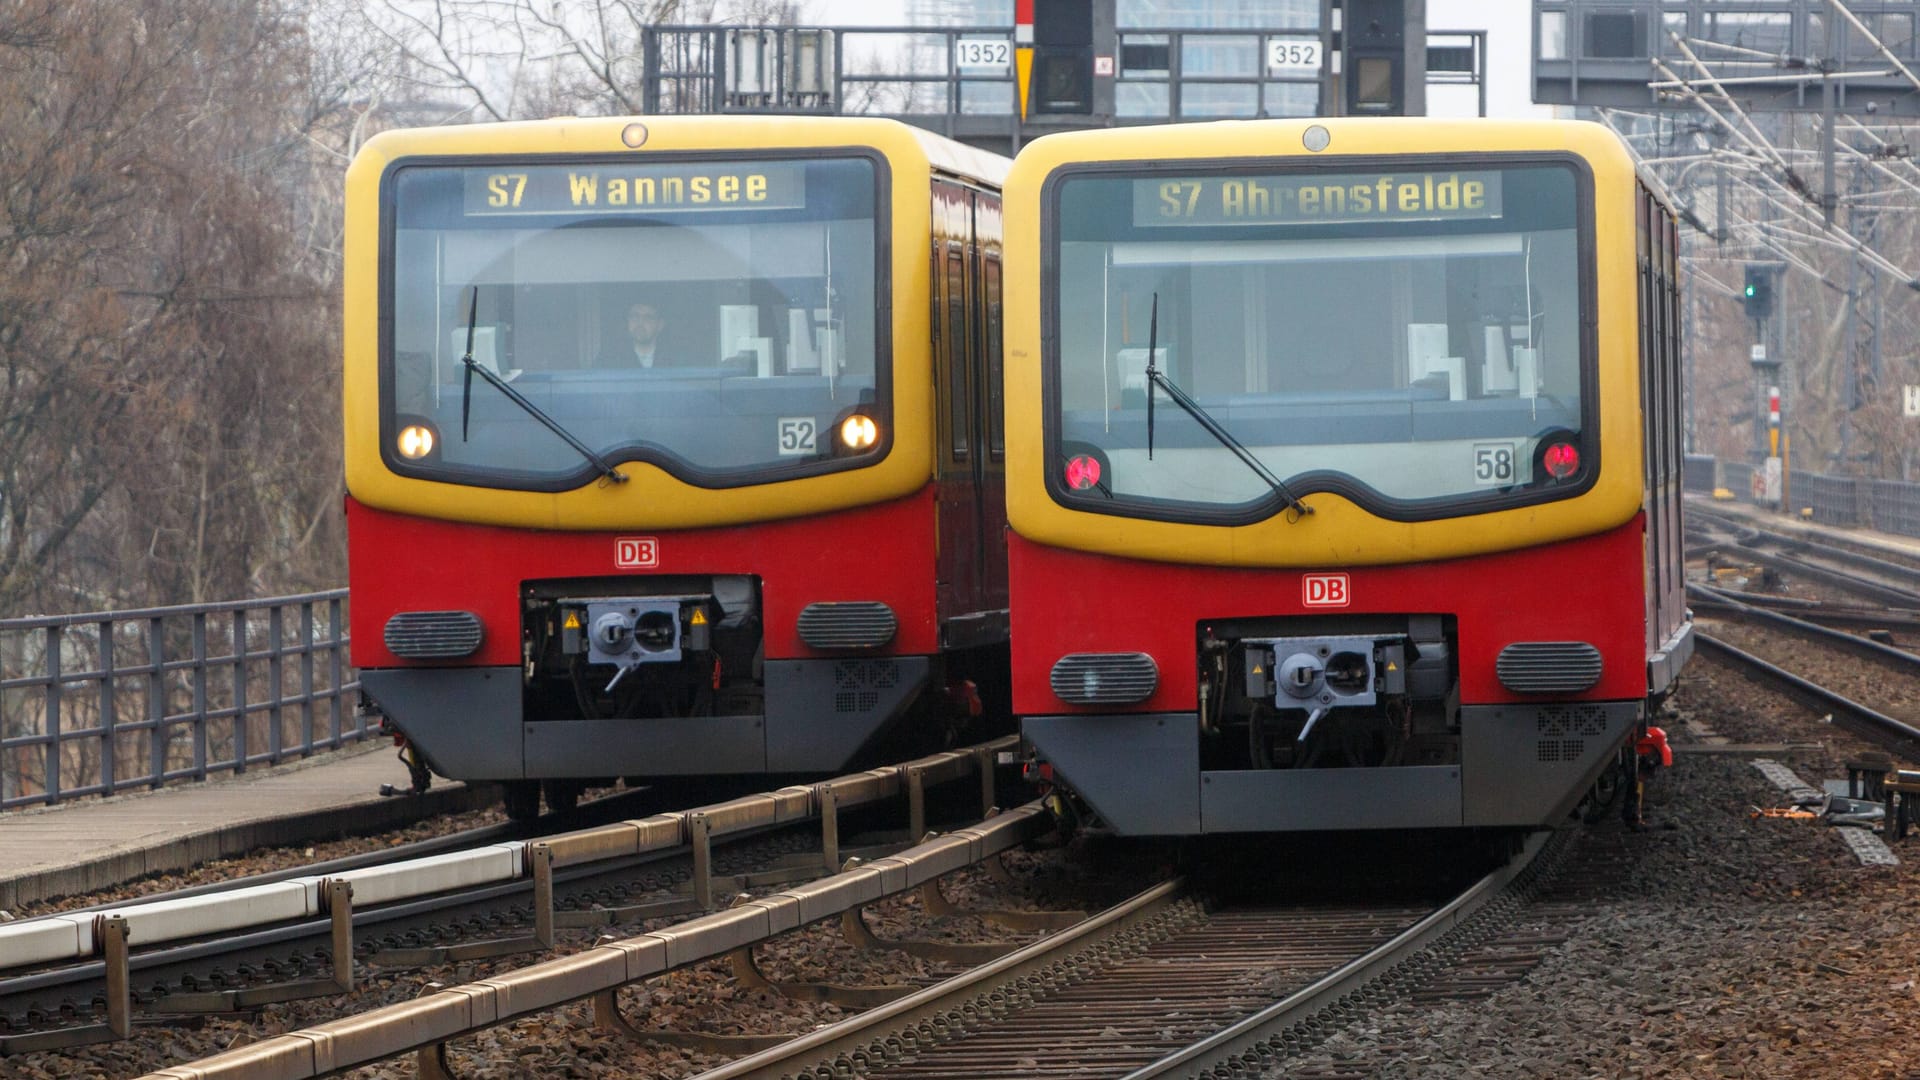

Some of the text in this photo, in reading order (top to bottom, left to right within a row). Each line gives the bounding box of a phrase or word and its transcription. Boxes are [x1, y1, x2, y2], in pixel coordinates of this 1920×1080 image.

[959, 44, 1008, 63] 1352
[1275, 45, 1315, 64] 352
[487, 172, 768, 208] S7 Wannsee
[1159, 173, 1485, 216] S7 Ahrensfelde
[781, 421, 815, 450] 52
[1476, 449, 1512, 479] 58
[620, 542, 653, 563] DB
[1309, 579, 1344, 601] DB
